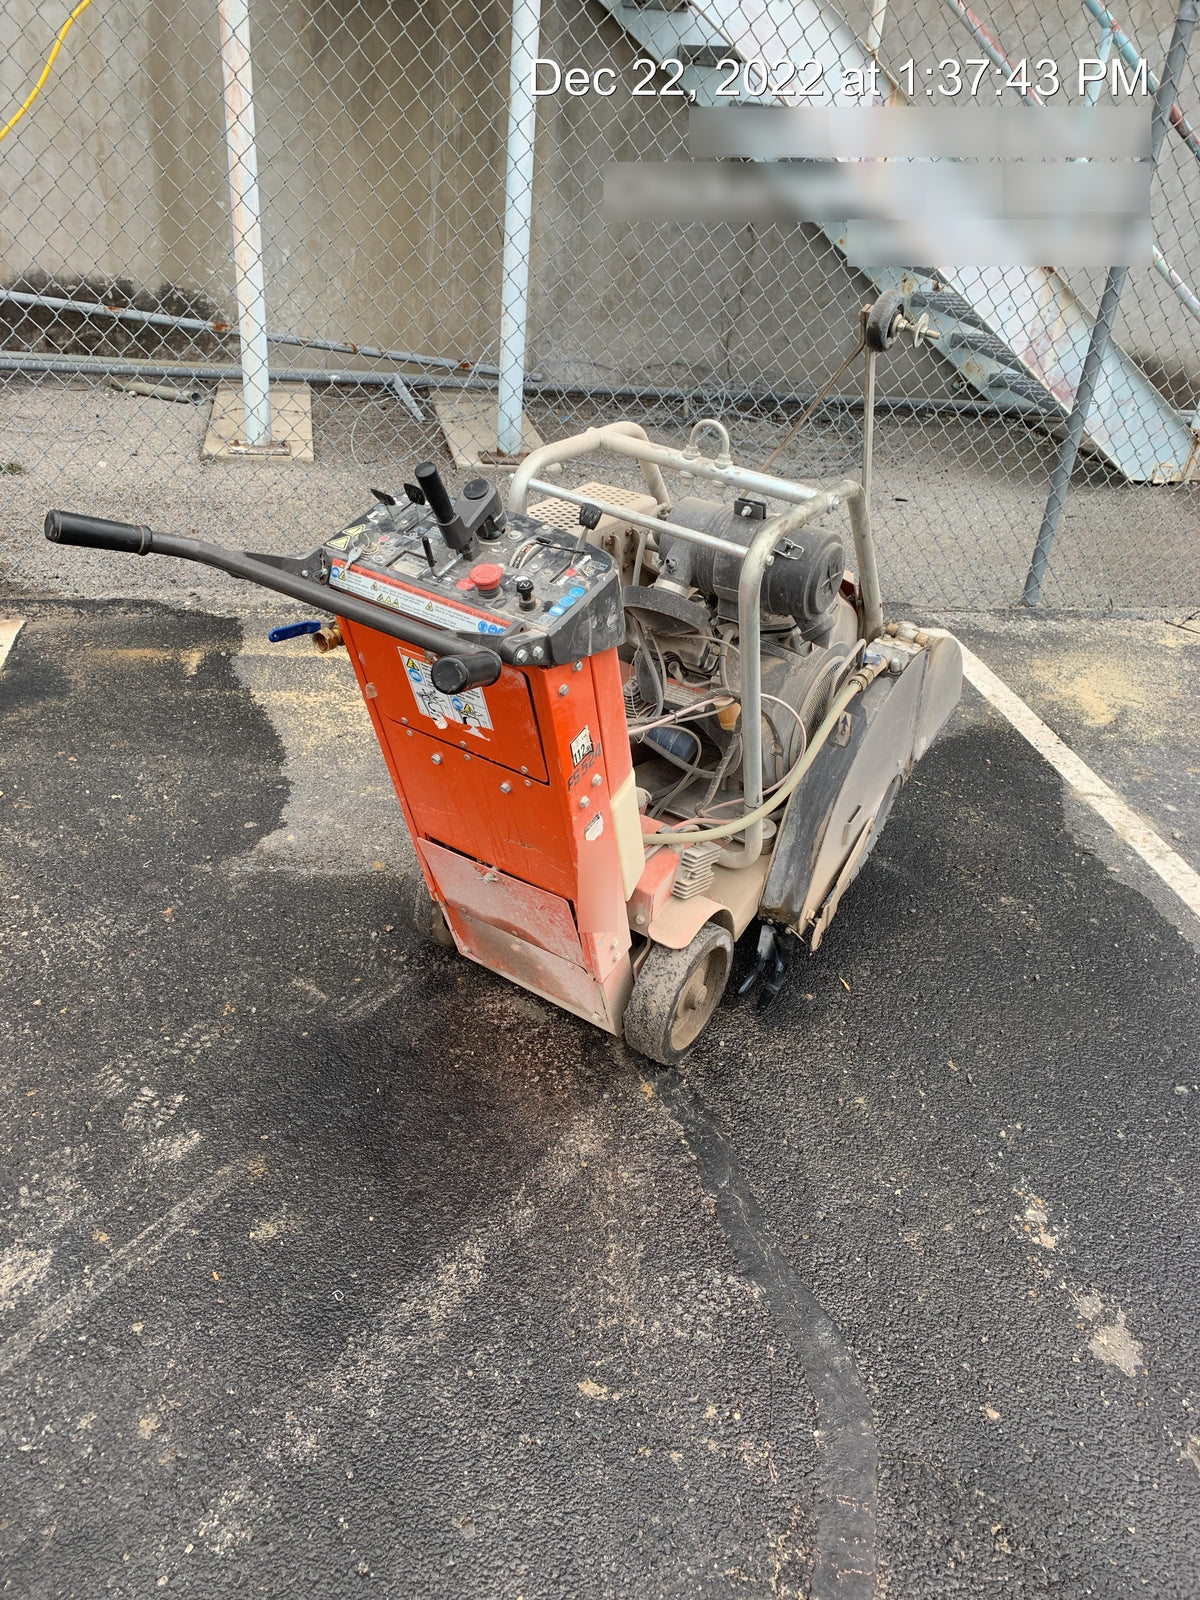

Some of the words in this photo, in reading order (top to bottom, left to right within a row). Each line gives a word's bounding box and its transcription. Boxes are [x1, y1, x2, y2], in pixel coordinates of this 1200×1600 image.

[568, 768, 580, 792] FS
[582, 742, 601, 775] 524
[574, 744, 585, 764] 112
